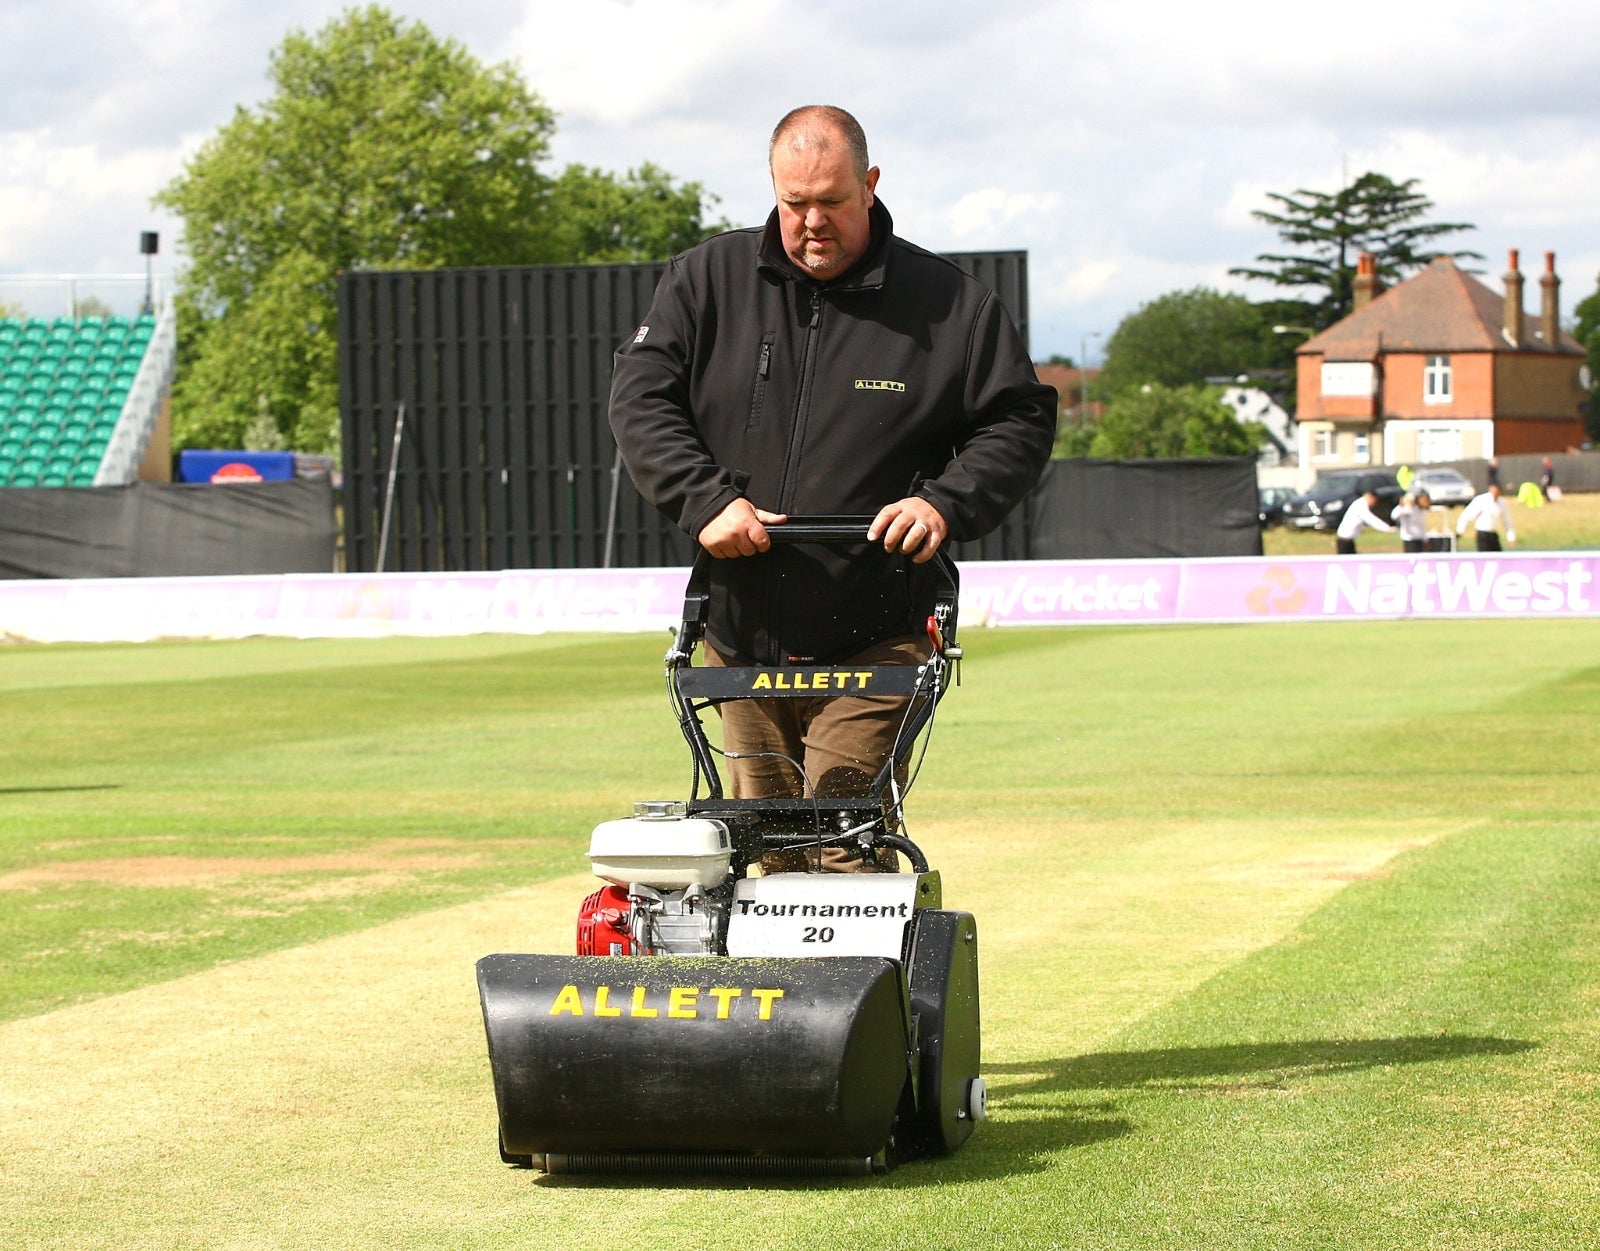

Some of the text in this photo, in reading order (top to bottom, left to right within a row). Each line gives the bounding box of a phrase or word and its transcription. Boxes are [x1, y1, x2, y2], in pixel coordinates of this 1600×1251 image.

[960, 574, 1161, 616] m/cricket
[1323, 561, 1592, 614] NatWest
[751, 672, 873, 690] ALLETT
[737, 900, 908, 918] Tournament
[802, 926, 835, 943] 20
[548, 984, 785, 1020] ALLETT
